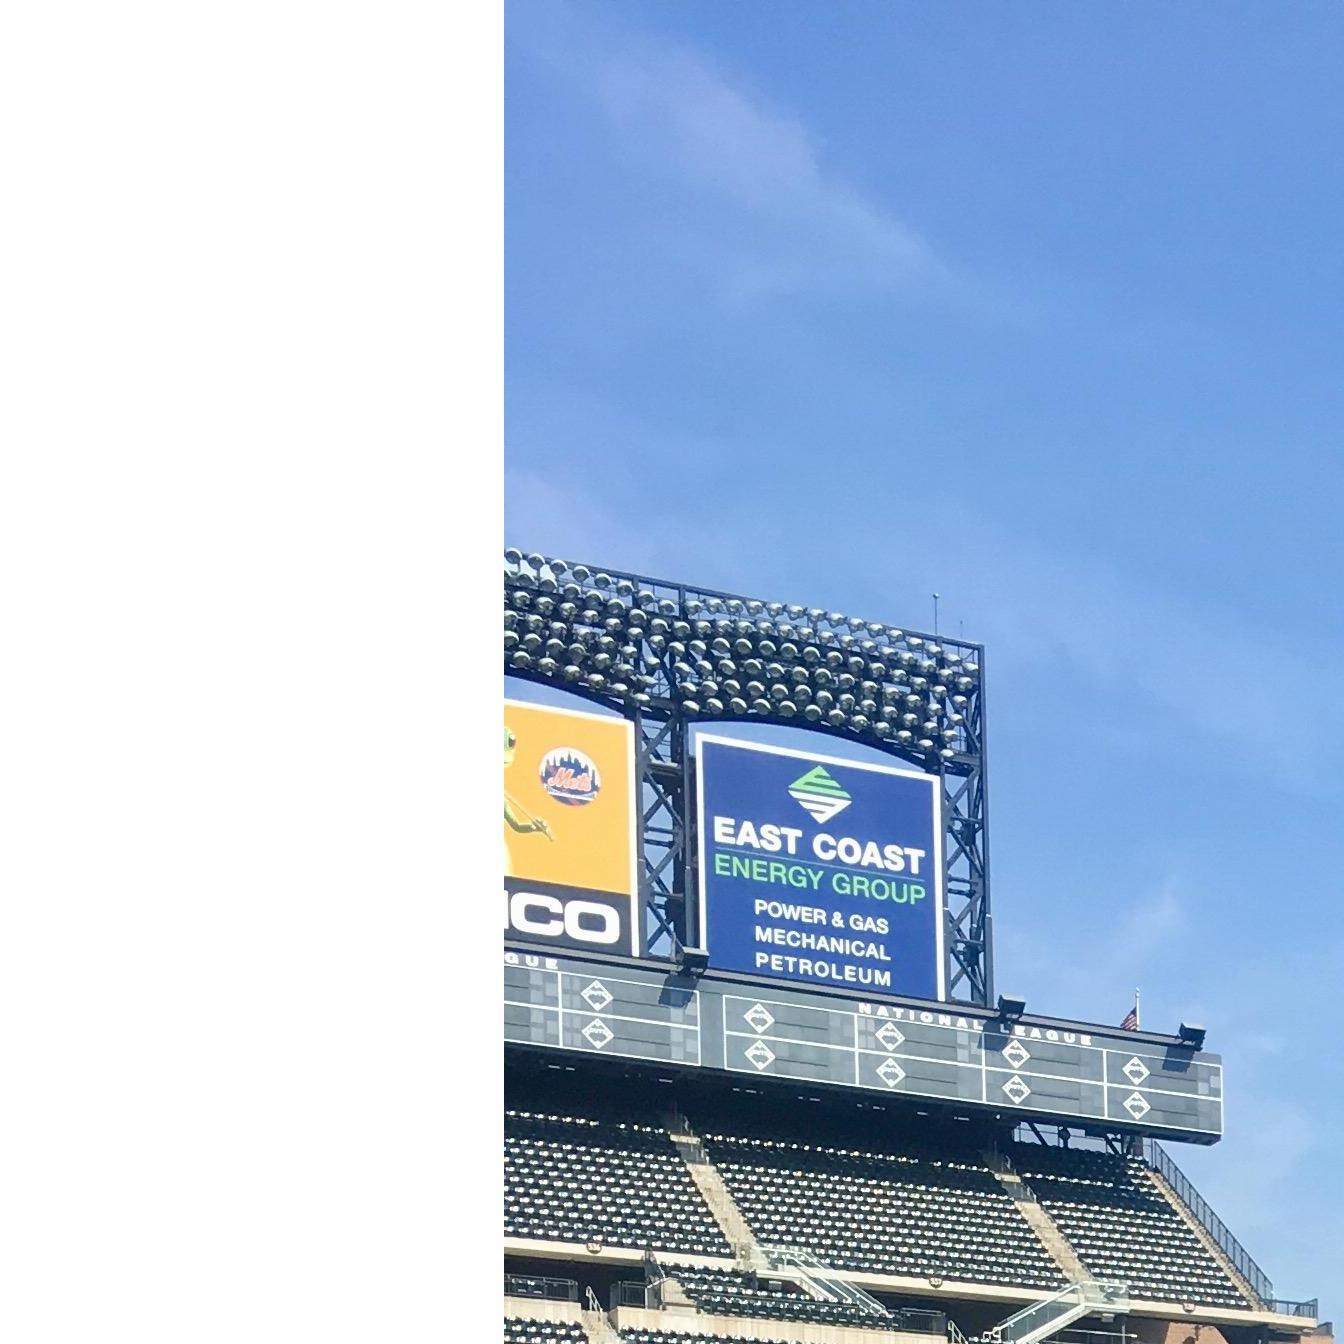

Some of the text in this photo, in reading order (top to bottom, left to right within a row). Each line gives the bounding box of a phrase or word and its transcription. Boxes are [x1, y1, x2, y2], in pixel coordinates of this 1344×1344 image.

[714, 816, 926, 874] EAST COAST
[715, 854, 926, 905] ENERGY GROUP
[754, 899, 889, 934] POWER & GAS
[755, 926, 891, 961] MECHANICAL
[755, 952, 892, 987] PETROLEUM
[858, 1002, 1092, 1046] NATIONAL LEAGUE
